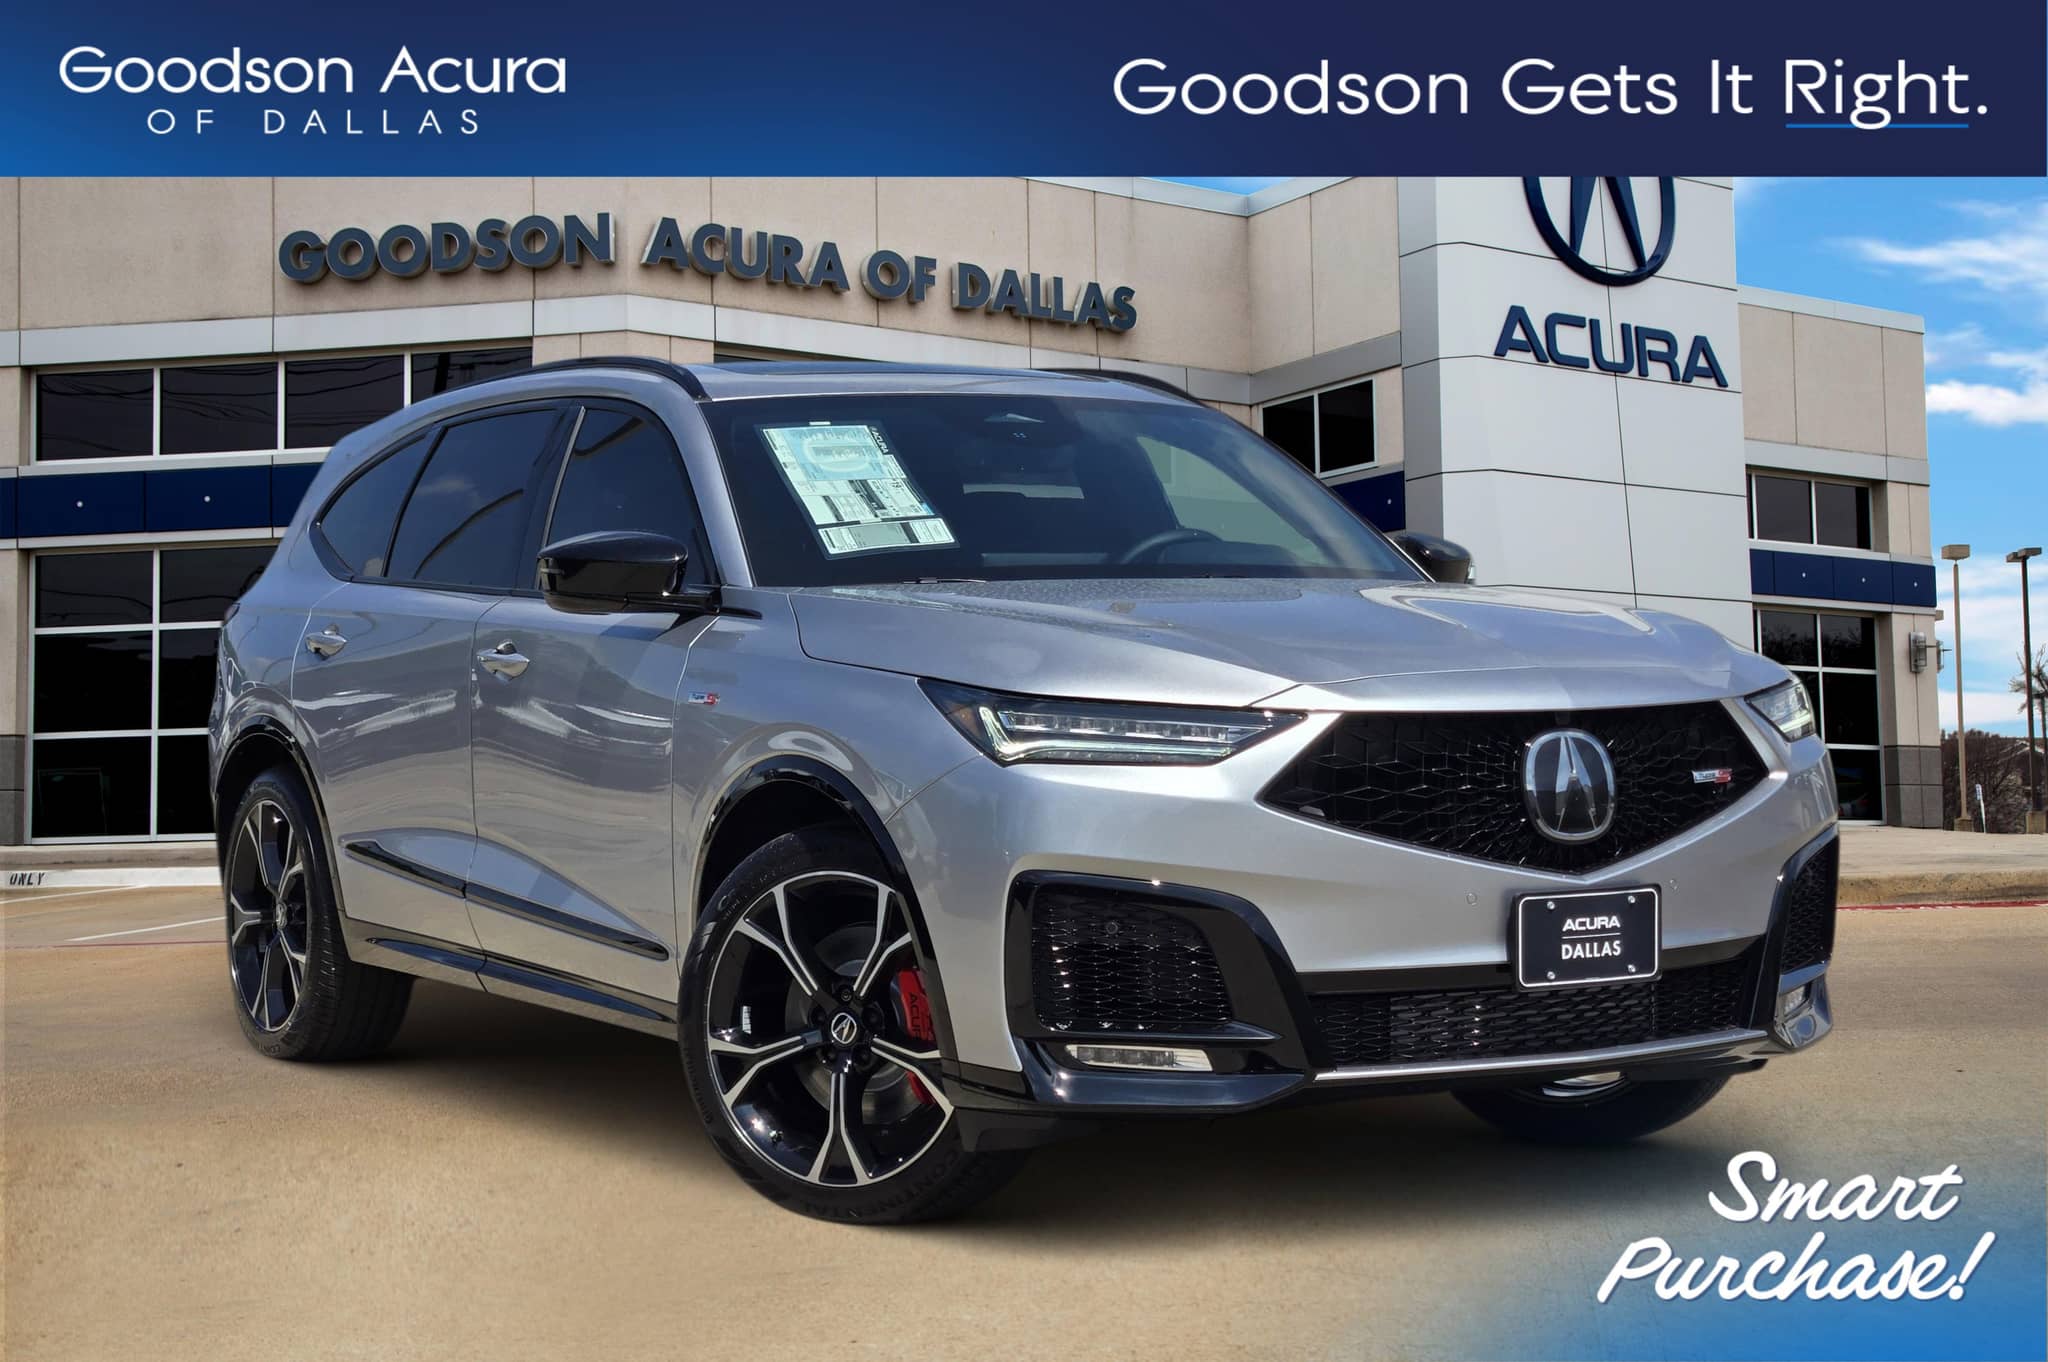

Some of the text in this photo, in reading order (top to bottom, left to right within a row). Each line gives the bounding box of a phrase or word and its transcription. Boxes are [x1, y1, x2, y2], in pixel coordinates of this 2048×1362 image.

[279, 212, 1138, 332] GOODSON ACURA OF DALLAS
[1494, 305, 1728, 388] ACURA
[9, 872, 46, 886] ONLY
[1562, 915, 1621, 932] ACURA
[1561, 940, 1621, 960] DALLAS
[909, 992, 922, 1040] ACUR
